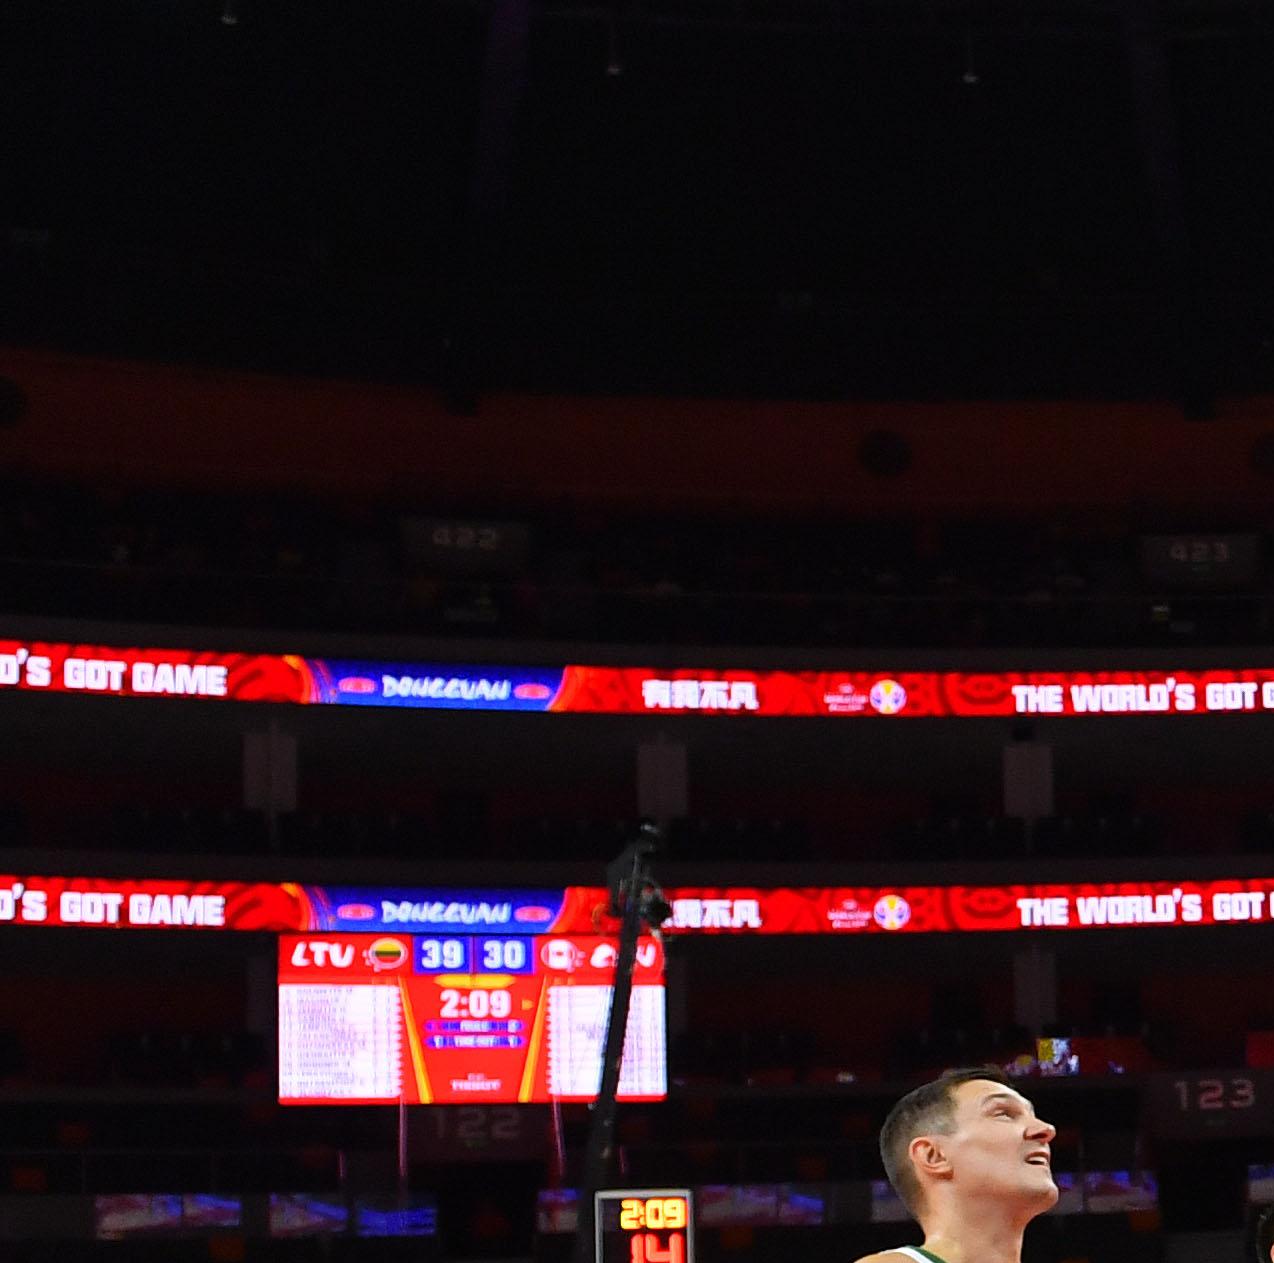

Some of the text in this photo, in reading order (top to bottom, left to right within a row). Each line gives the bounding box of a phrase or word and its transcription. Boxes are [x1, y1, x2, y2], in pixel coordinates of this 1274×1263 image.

[64, 659, 126, 690] GOT
[132, 662, 227, 696] GAME
[1012, 684, 1063, 713] THE
[1071, 677, 1196, 712] WORLD'S
[1206, 682, 1257, 711] GOT
[60, 891, 124, 923] GOT
[129, 894, 225, 926] GAME
[1017, 898, 1068, 927] THE
[1077, 888, 1202, 924] WORLD'S
[1213, 891, 1264, 921] GOT
[291, 942, 354, 967] LTU
[422, 939, 465, 969] 39
[484, 939, 526, 968] 30
[440, 989, 511, 1018] 2:09
[1175, 1078, 1256, 1111] 123
[621, 1199, 687, 1229] 2:09
